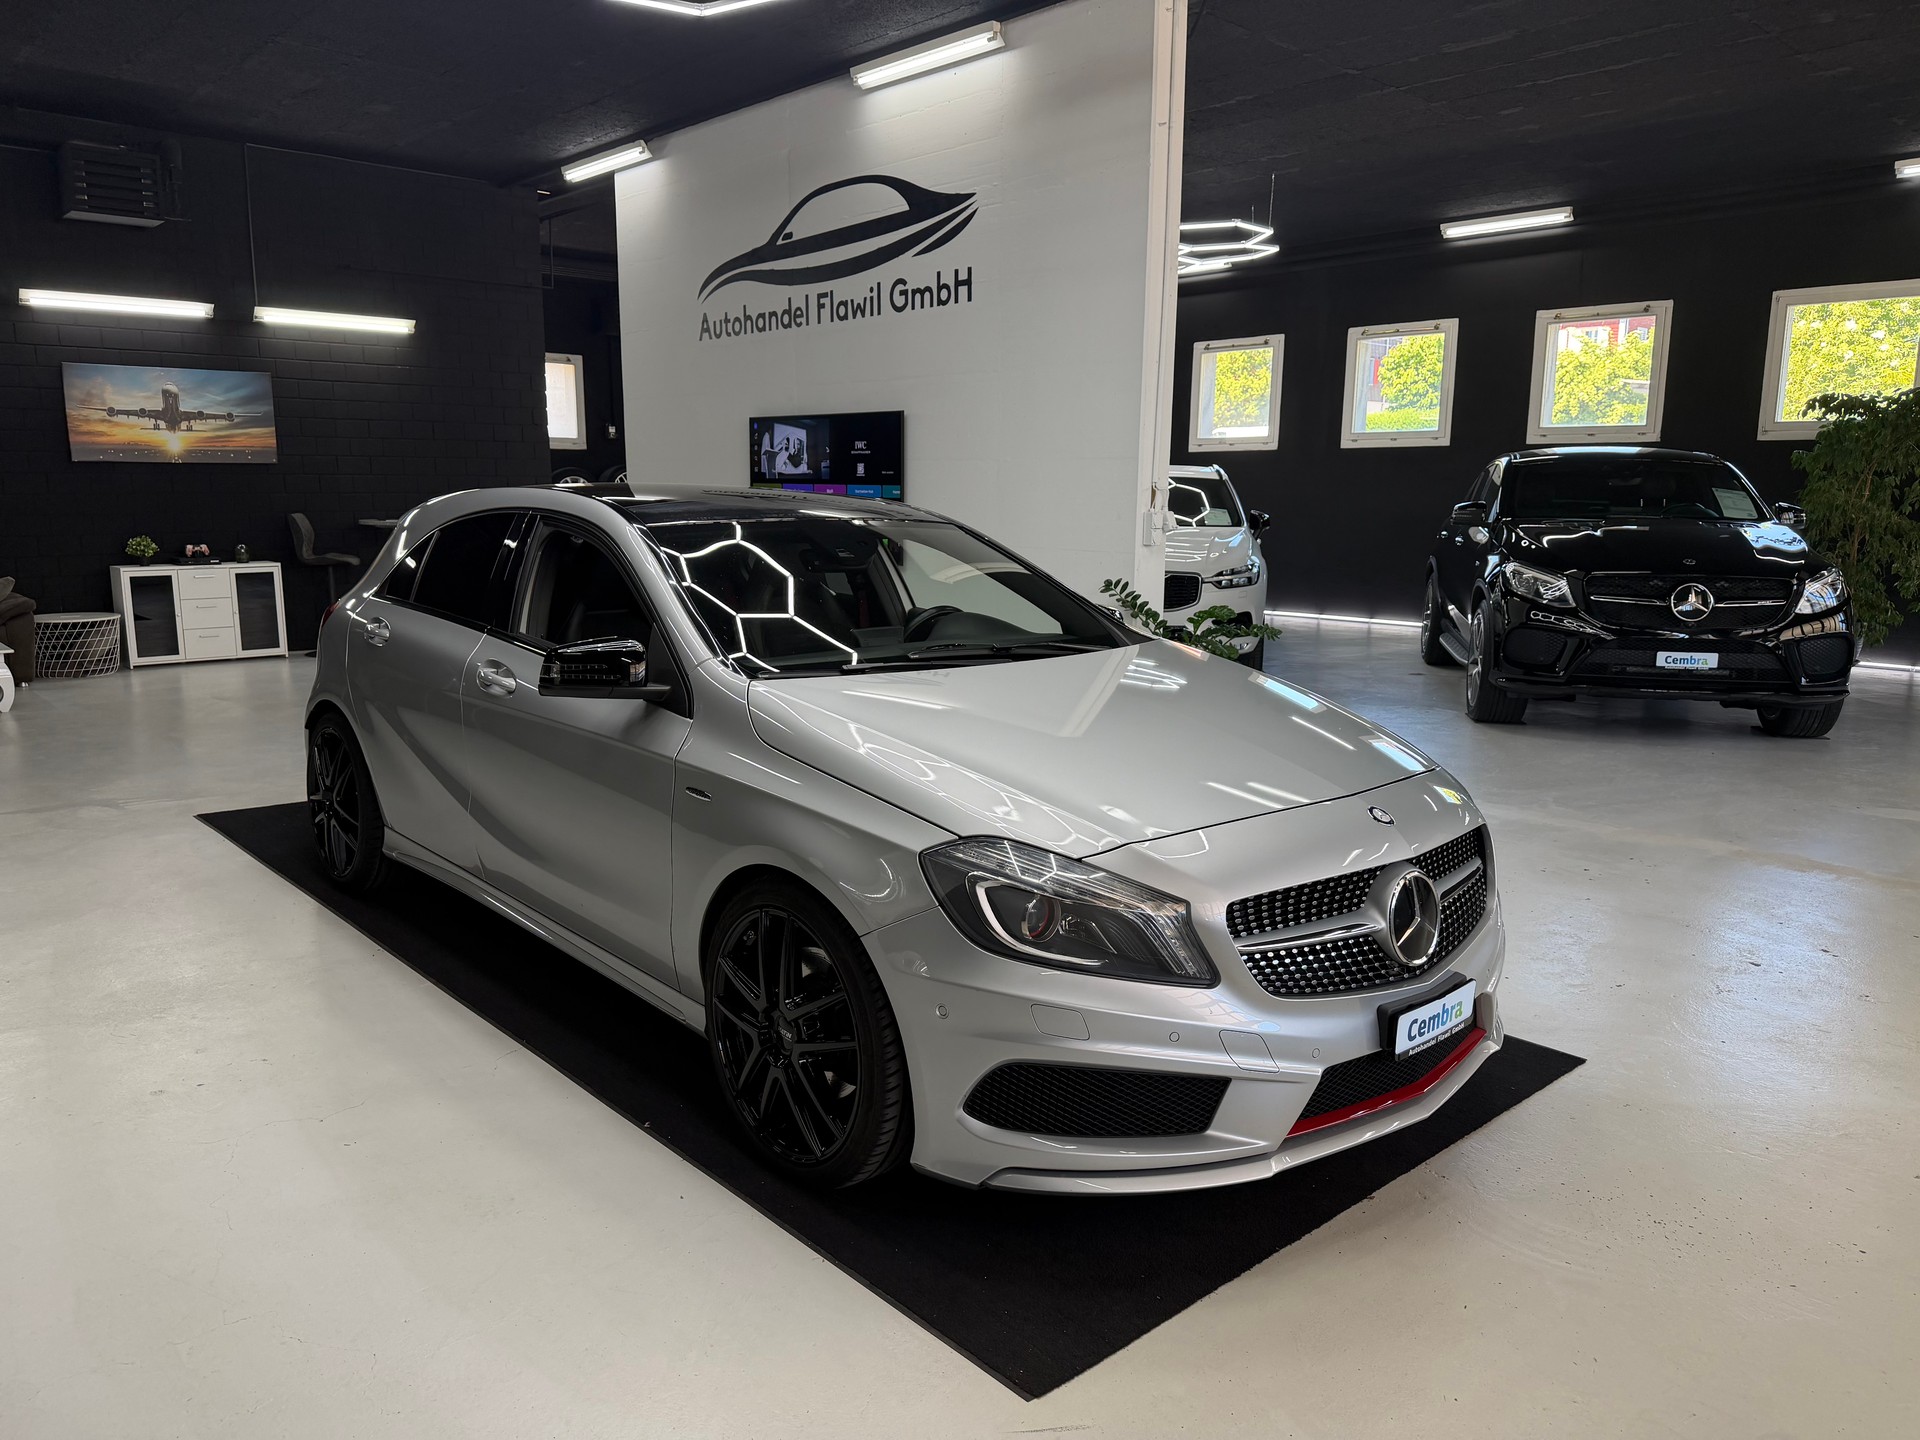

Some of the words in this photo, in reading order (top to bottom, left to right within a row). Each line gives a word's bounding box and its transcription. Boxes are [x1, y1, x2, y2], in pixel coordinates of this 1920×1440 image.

[699, 294, 809, 341] Autohandel
[816, 281, 882, 324] Flawil
[889, 266, 972, 313] GmbH
[1664, 655, 1709, 666] Cembra
[1407, 1001, 1463, 1042] Cembra
[1408, 1037, 1437, 1056] Autohandel
[1437, 1030, 1451, 1042] Flawil
[1452, 1022, 1465, 1034] GmbH
